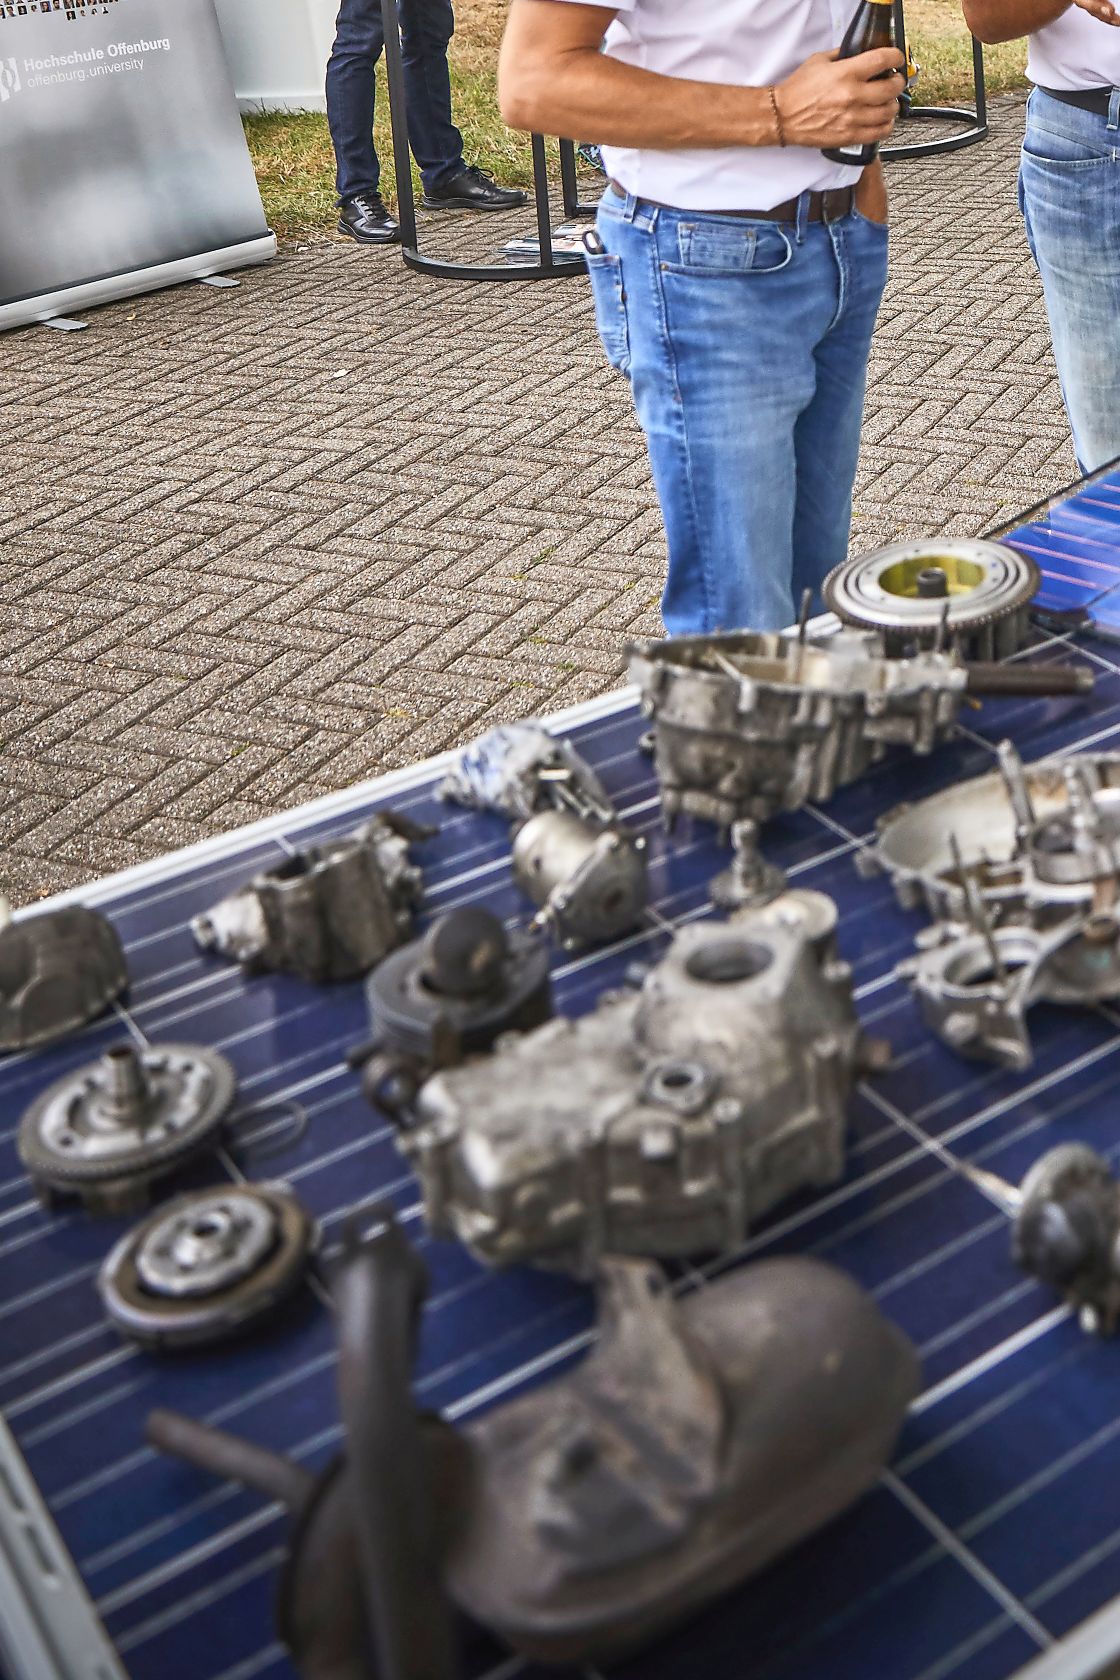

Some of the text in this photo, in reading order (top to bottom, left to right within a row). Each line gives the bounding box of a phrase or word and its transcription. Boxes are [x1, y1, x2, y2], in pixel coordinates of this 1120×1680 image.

[23, 38, 171, 72] Hochschule Offenburg
[27, 57, 144, 88] offenburg.university
